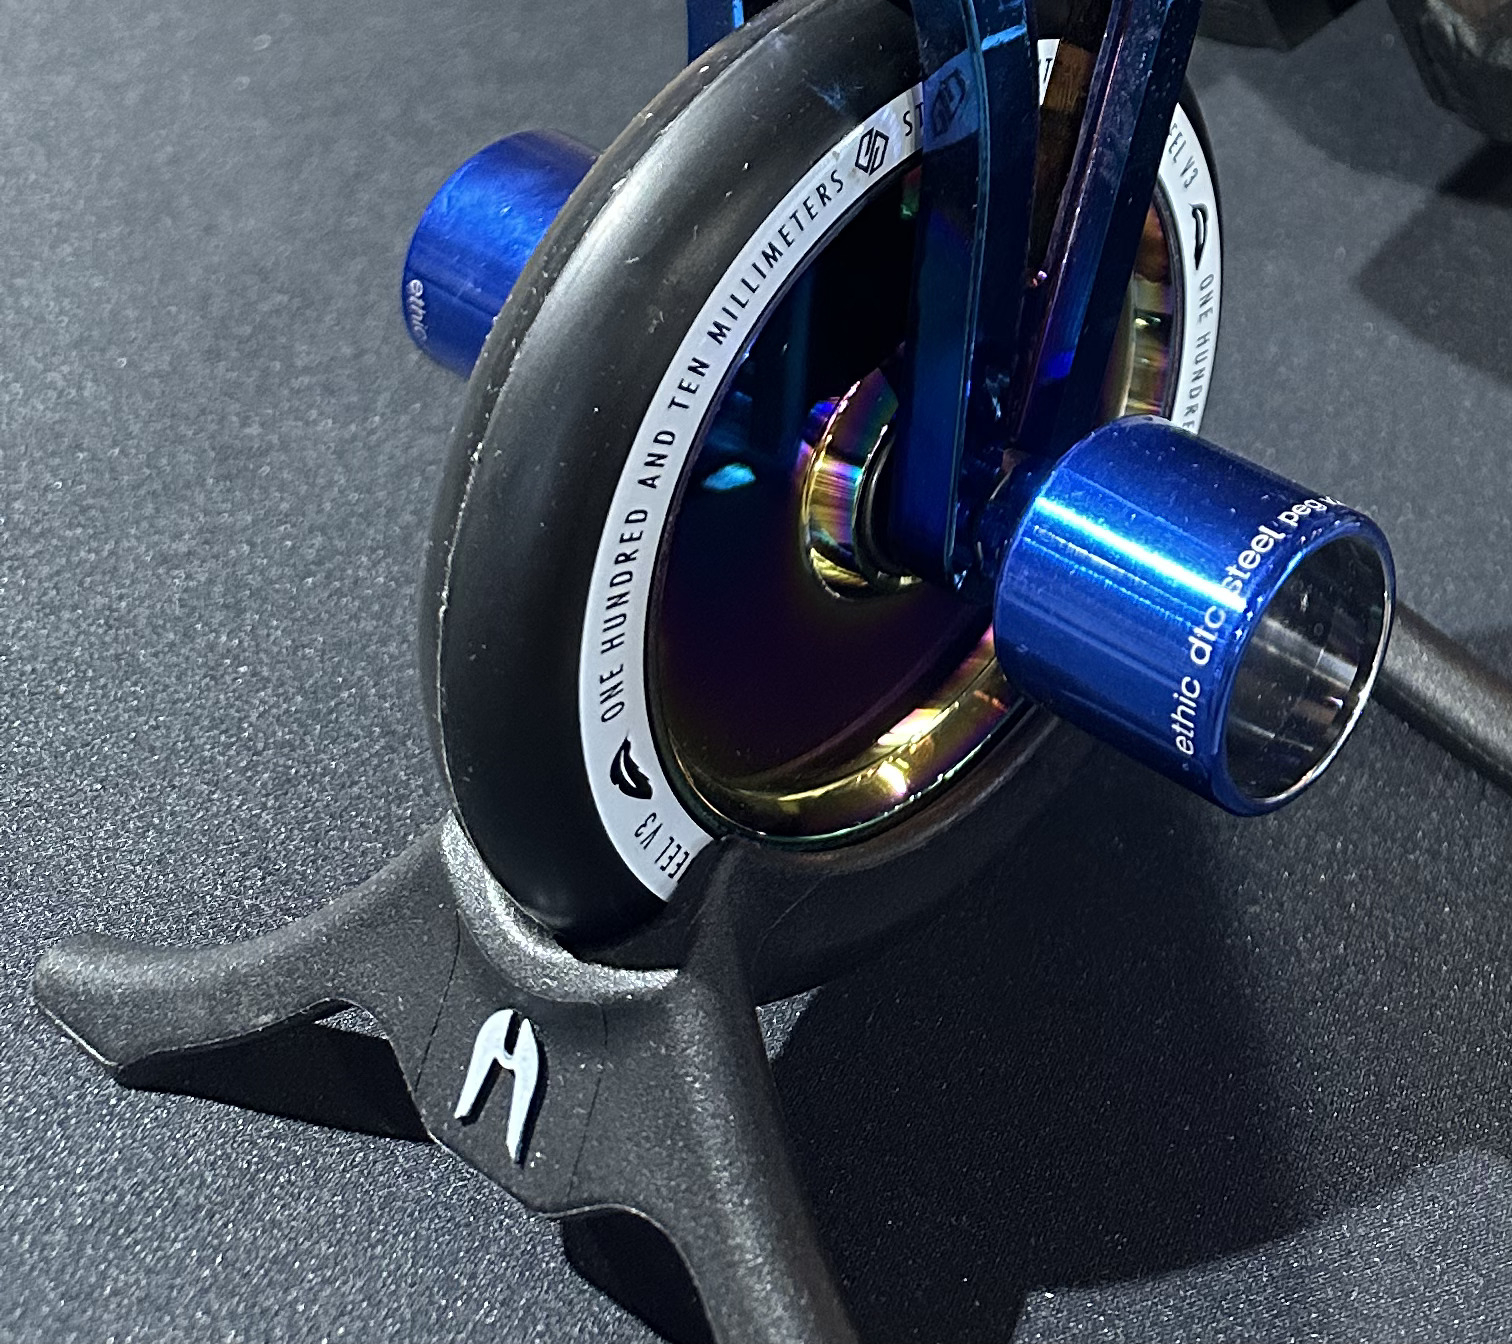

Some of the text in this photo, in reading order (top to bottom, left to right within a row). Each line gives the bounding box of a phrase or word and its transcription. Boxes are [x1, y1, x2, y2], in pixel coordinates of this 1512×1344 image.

[1199, 273, 1214, 324] ONE
[600, 169, 844, 724] ONE HUNDRED AND TEN MILLIMETERS
[1171, 676, 1201, 756] ethic
[1188, 606, 1226, 665] dtc
[1221, 525, 1286, 598] steel
[1277, 499, 1328, 528] peg
[634, 812, 663, 850] V3
